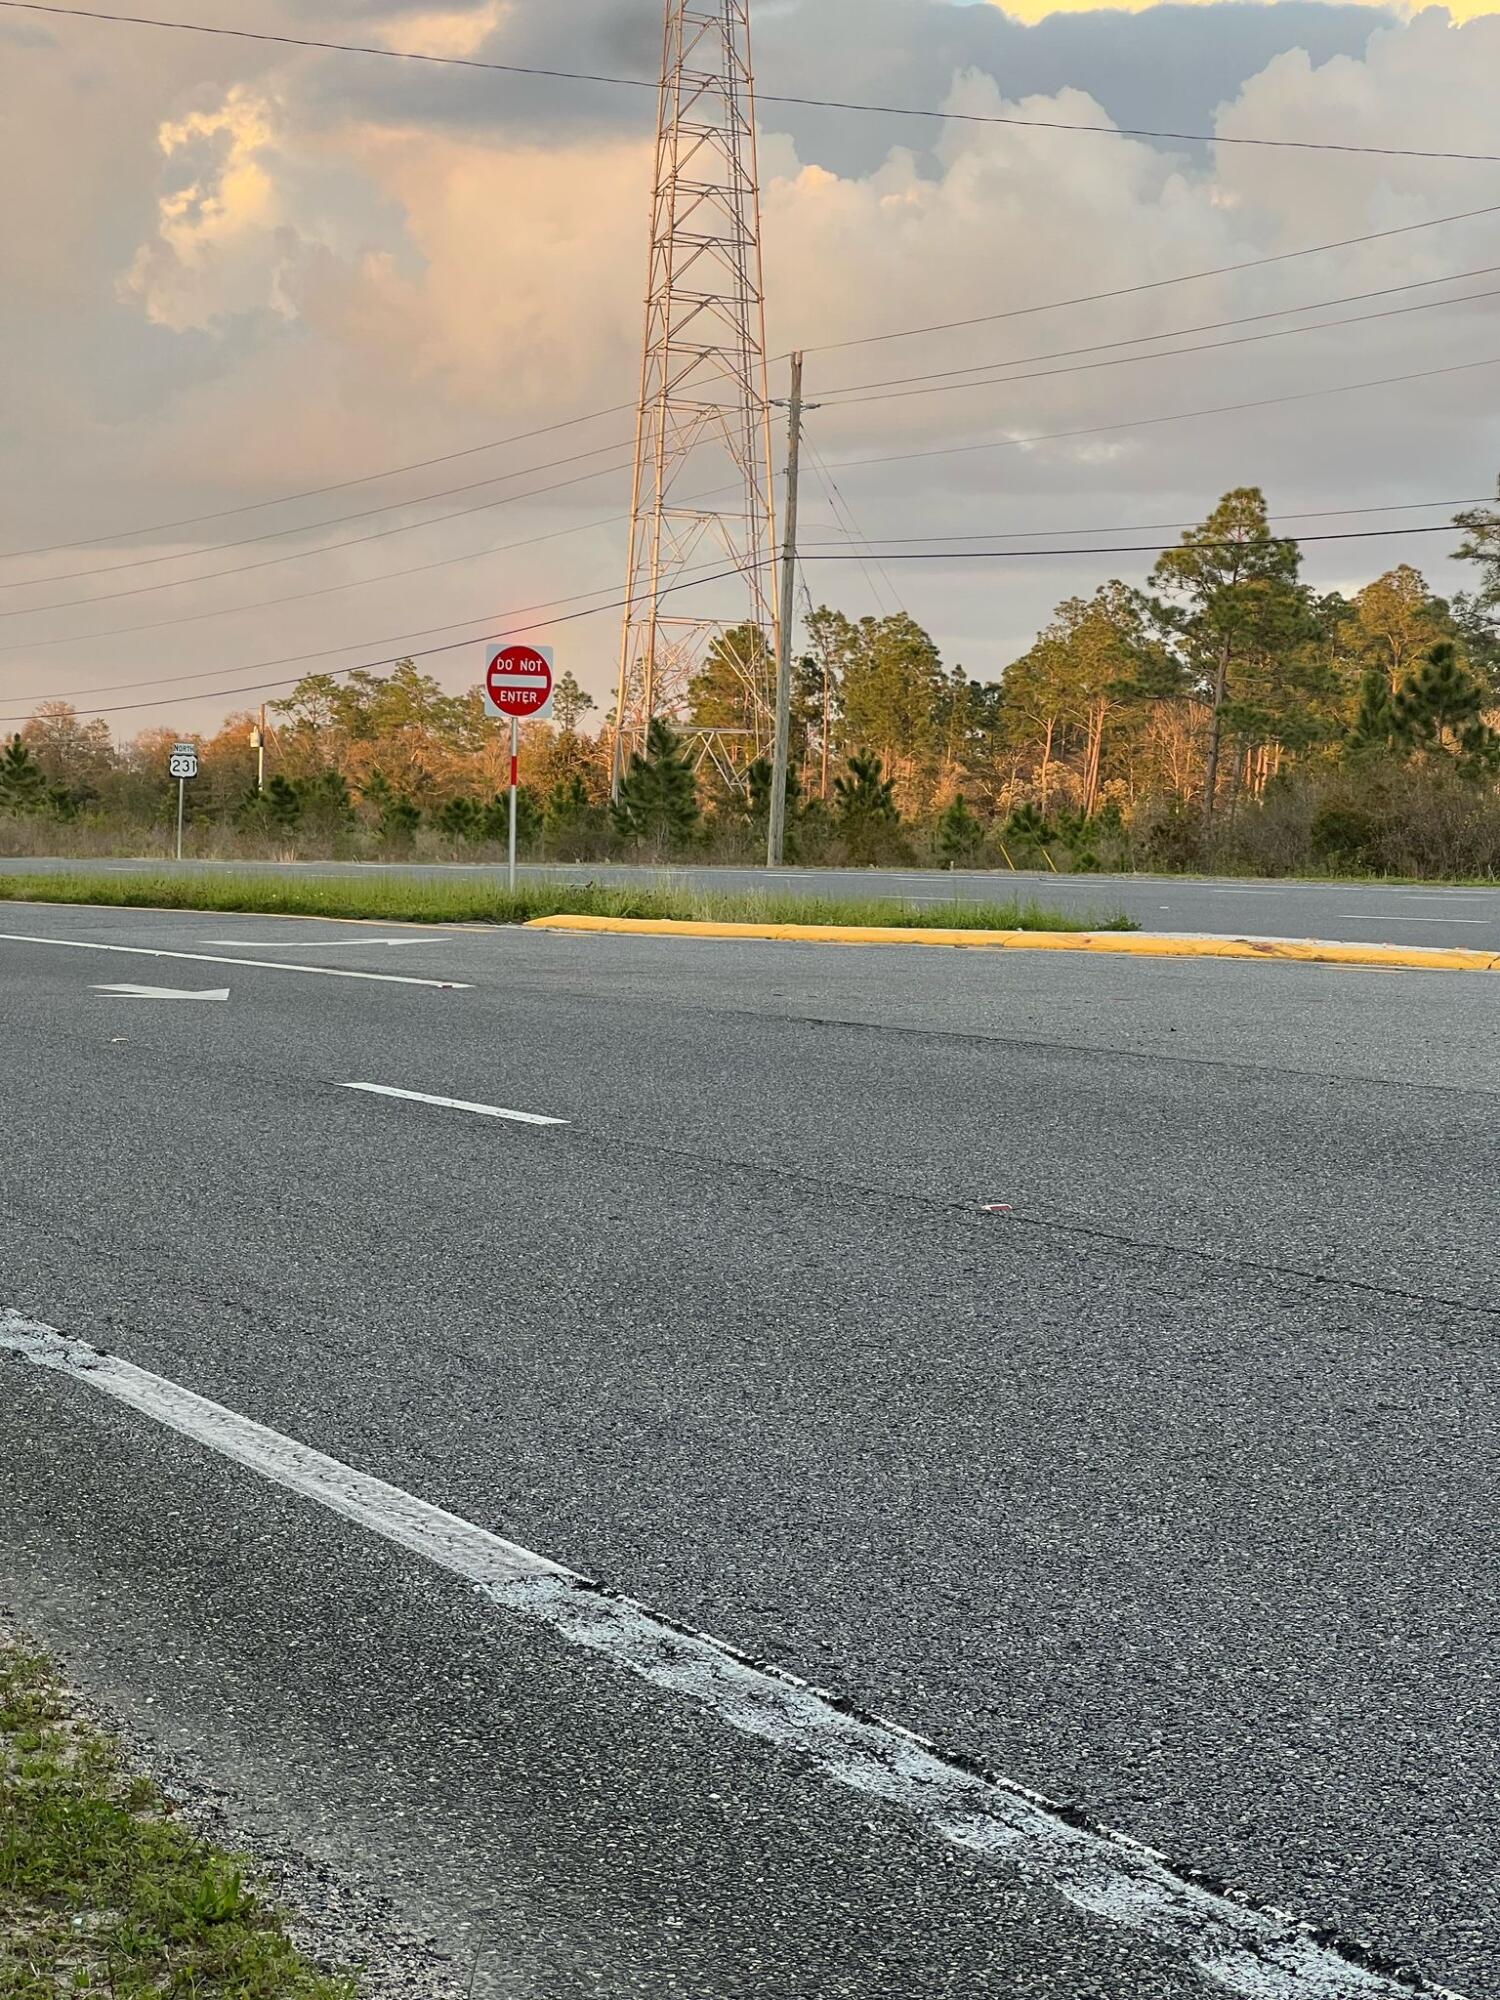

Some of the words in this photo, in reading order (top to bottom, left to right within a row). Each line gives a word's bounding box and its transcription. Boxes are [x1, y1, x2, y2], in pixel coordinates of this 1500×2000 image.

[496, 659, 513, 671] DO
[520, 660, 542, 672] NOT
[500, 690, 537, 703] ENTER
[172, 759, 196, 773] 231
